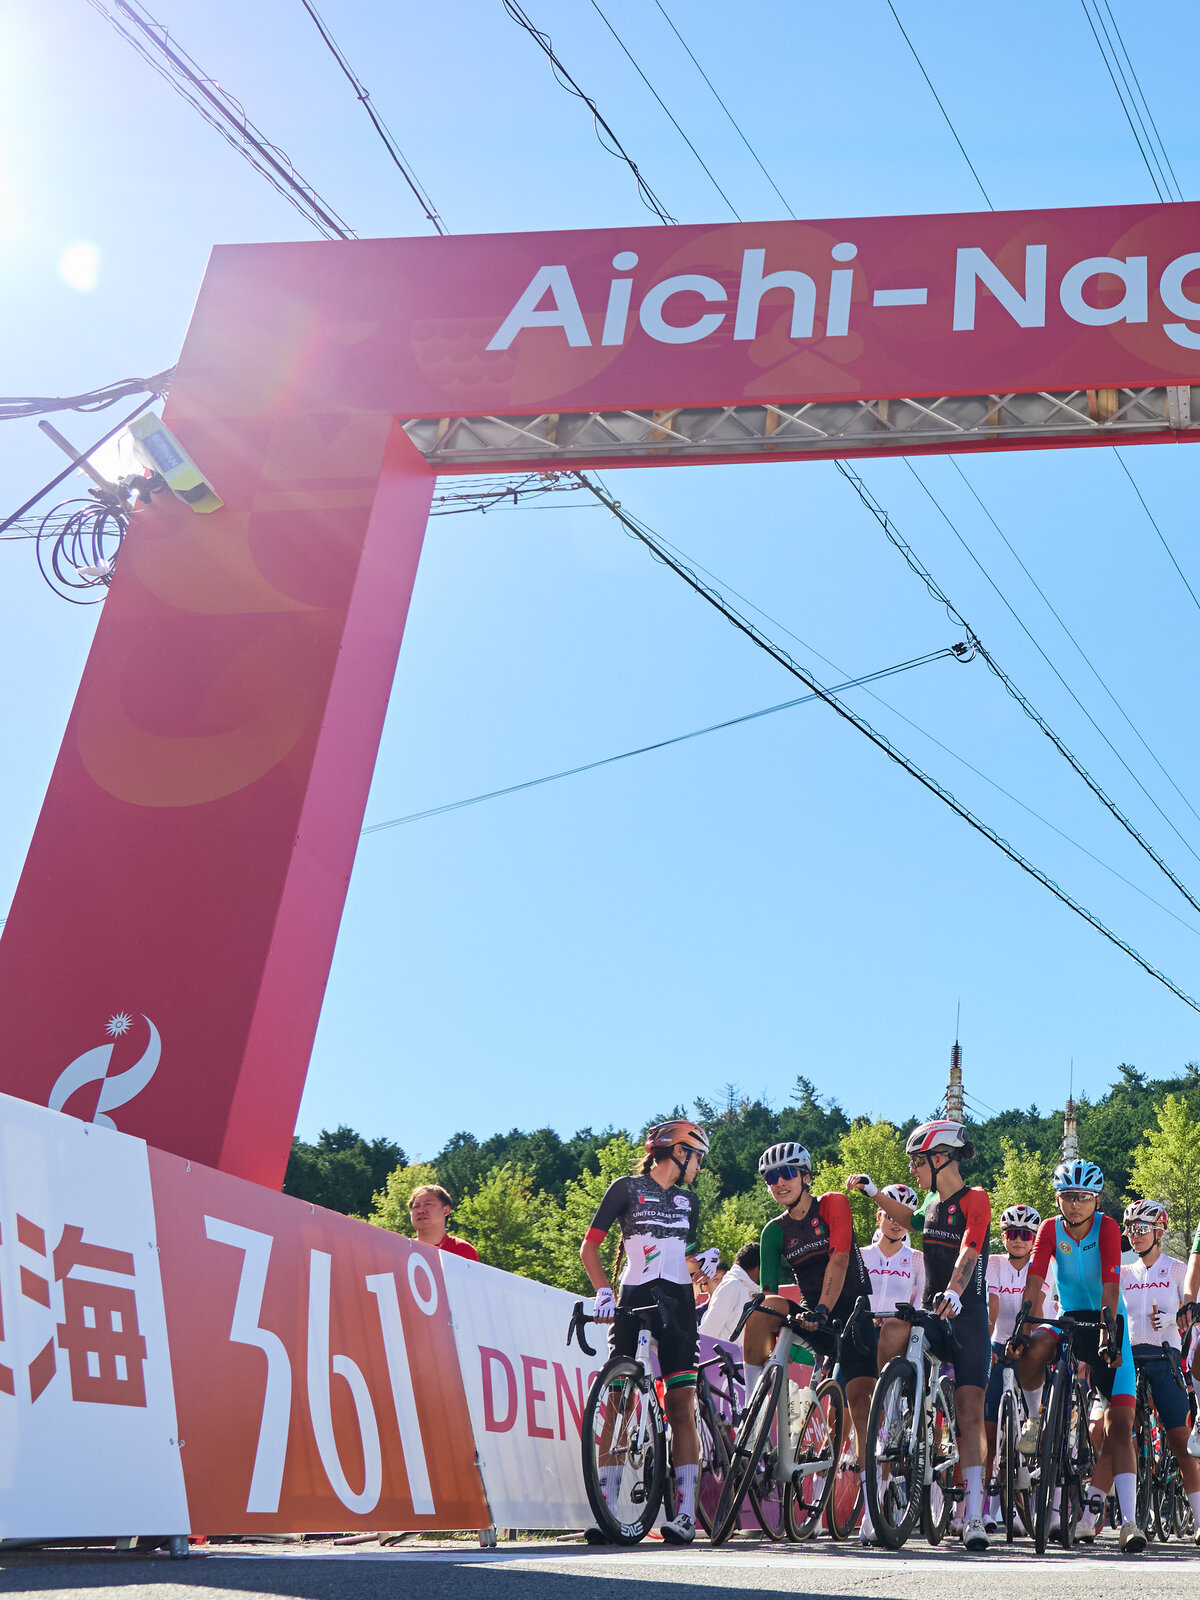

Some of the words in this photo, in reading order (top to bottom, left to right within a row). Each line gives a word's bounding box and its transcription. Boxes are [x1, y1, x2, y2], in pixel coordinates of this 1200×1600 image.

[633, 1210, 656, 1218] UNITED
[657, 1211, 672, 1219] ARAB
[787, 1237, 830, 1260] AFGHANISTA
[1125, 1281, 1170, 1291] JAPAN
[0, 1213, 148, 1408] 海
